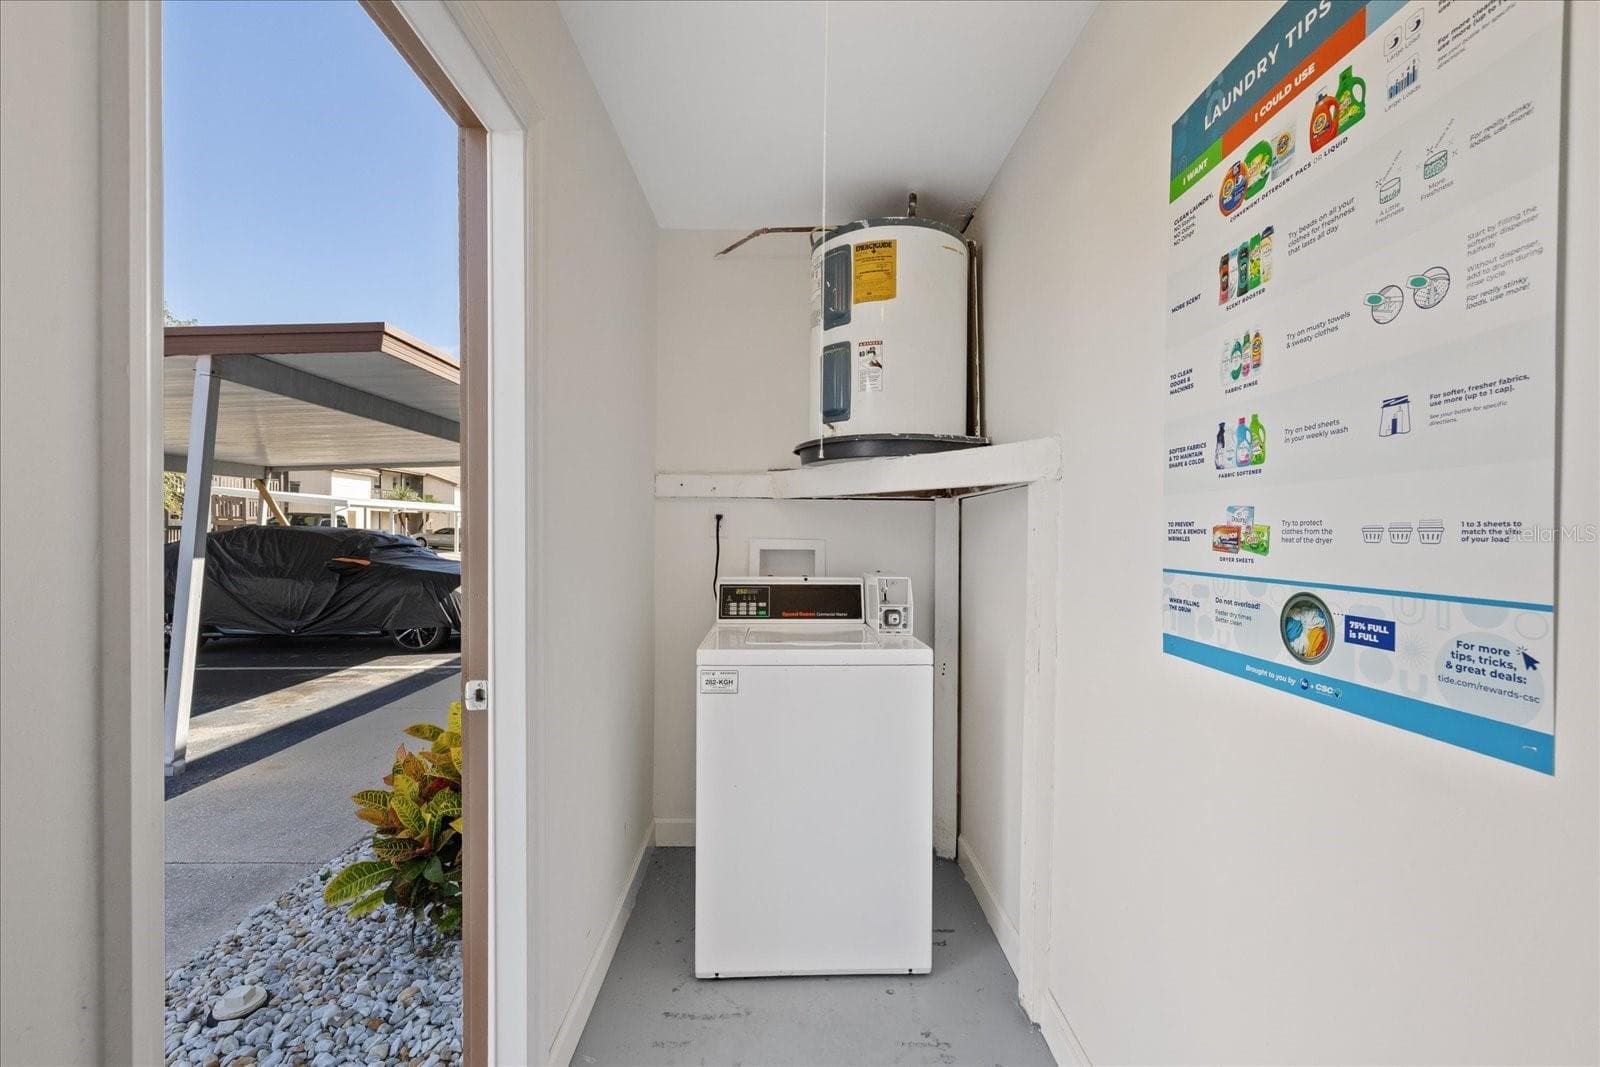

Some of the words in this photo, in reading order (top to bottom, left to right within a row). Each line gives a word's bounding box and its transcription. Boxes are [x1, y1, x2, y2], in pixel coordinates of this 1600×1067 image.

[1204, 43, 1279, 130] LAUNDRY
[1286, 0, 1331, 48] TIPS
[1254, 112, 1258, 122] I
[1259, 83, 1292, 117] COULD
[1294, 62, 1316, 86] USE
[1187, 158, 1208, 182] WANT
[1230, 198, 1260, 222] CONVENIENT
[1262, 174, 1293, 200] DETERGENT
[1295, 162, 1311, 176] PACS
[1324, 137, 1348, 156] LIQUID
[1288, 231, 1298, 239] Try
[1299, 218, 1318, 233] beads
[1319, 213, 1327, 222] on
[1329, 205, 1337, 216] all
[1338, 197, 1354, 212] your
[1467, 229, 1485, 240] Start
[1487, 225, 1496, 233] by
[1523, 206, 1537, 216] the
[1288, 231, 1310, 247] clothes
[1311, 226, 1320, 234] for
[1321, 206, 1355, 229] freshness
[1288, 245, 1300, 256] that
[1302, 237, 1316, 248] lasts
[1317, 230, 1325, 240] all
[1326, 224, 1339, 236] day
[1467, 271, 1480, 281] add
[1171, 303, 1185, 313] MORE
[1186, 293, 1201, 306] SCENT
[1226, 300, 1241, 311] SCENT
[1306, 321, 1327, 333] musty
[1328, 312, 1351, 324] towels
[1292, 335, 1313, 347] sweaty
[1314, 325, 1338, 338] clothes
[1178, 368, 1193, 378] CLEAN
[1170, 378, 1186, 388] ODORS
[1170, 383, 1194, 395] MACHINES
[1225, 385, 1242, 394] FABRIC
[1243, 380, 1258, 389] RINSE
[1443, 388, 1467, 398] softer,
[1468, 381, 1497, 392] fresher
[1498, 374, 1530, 385] fabrics,
[1444, 396, 1462, 404] more
[1285, 428, 1293, 436] Try
[1304, 422, 1316, 432] bed
[1318, 419, 1340, 429] sheets
[1291, 435, 1305, 444] your
[1306, 430, 1329, 439] weekly
[1330, 426, 1349, 435] wash
[1169, 446, 1186, 455] SOFTER
[1187, 442, 1207, 451] FABRICS
[1180, 451, 1203, 460] MAINTAIN
[1169, 461, 1183, 469] SHAPE
[1188, 458, 1204, 466] COLOR
[1236, 468, 1262, 477] SOFTENER
[1315, 537, 1333, 545] dryer
[1169, 597, 1182, 605] WHEN
[1183, 599, 1200, 608] FILLING
[1178, 605, 1191, 613] DRUM
[1224, 598, 1233, 606] not
[1234, 600, 1261, 610] overload!
[1215, 609, 1229, 617] Faster
[1238, 612, 1252, 621] times
[1215, 616, 1229, 624] Better
[1230, 618, 1242, 627] clean
[1349, 621, 1366, 631] 75%
[1367, 623, 1390, 634] FULL
[1349, 630, 1356, 639] is
[1358, 632, 1379, 643] FULL
[1456, 640, 1475, 651] For
[1478, 645, 1511, 657] more
[1451, 650, 1475, 664] tips,
[1478, 656, 1517, 671] tricks,
[1245, 664, 1268, 678] Brought
[1268, 671, 1275, 679] to
[1276, 674, 1287, 682] you
[1288, 676, 1297, 686] by
[1315, 683, 1334, 694] CSC
[1445, 660, 1453, 669] &
[1455, 663, 1487, 677] great
[1490, 669, 1527, 685] deals:
[1438, 674, 1541, 704] tide.com/rewards-csc
